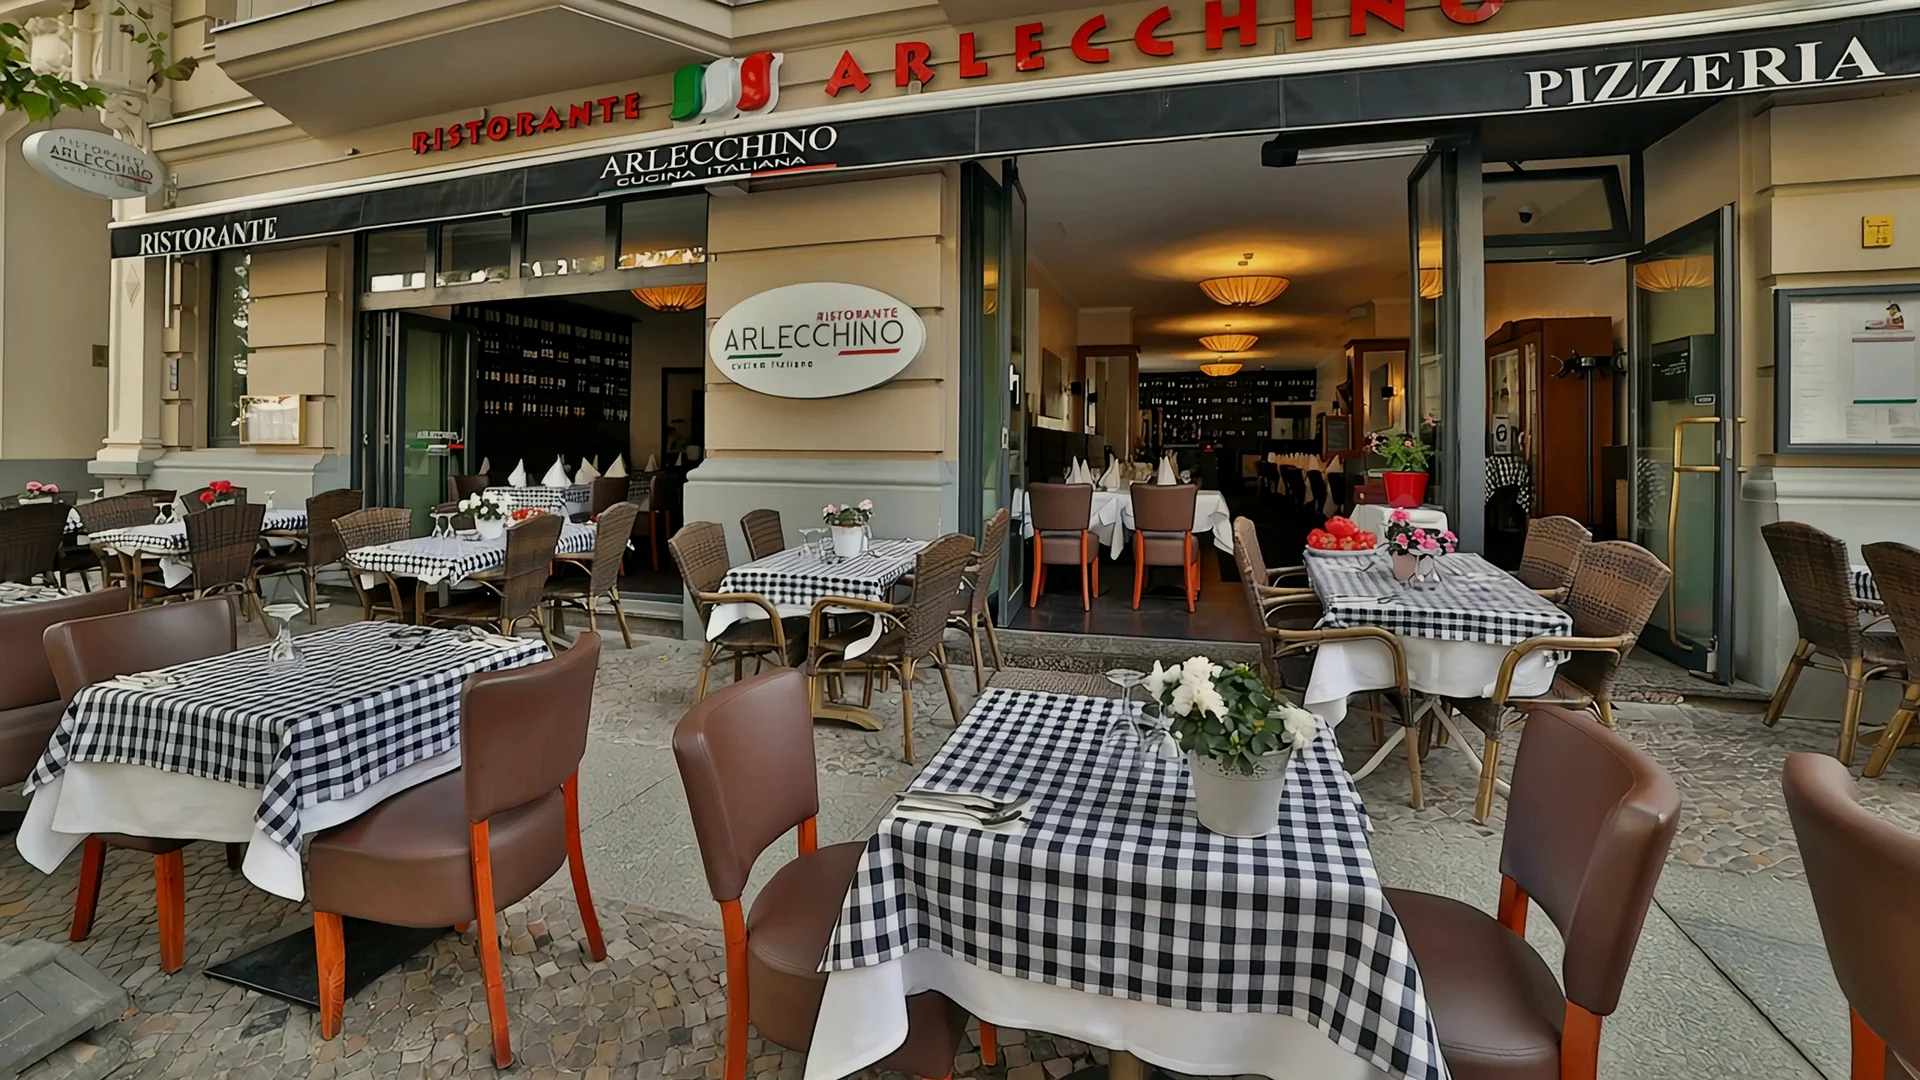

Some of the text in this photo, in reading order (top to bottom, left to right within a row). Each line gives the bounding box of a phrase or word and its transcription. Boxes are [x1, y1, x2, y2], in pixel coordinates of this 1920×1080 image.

[1525, 36, 1885, 108] PIZZERIA
[412, 92, 641, 154] RISTORANTE
[600, 125, 838, 179] ARLECCHINO
[616, 155, 806, 187] CUCINA ITALIANA
[138, 216, 278, 256] RISTORANTE
[816, 307, 898, 321] RISTORANTE
[724, 319, 904, 352] ARLECCHINO
